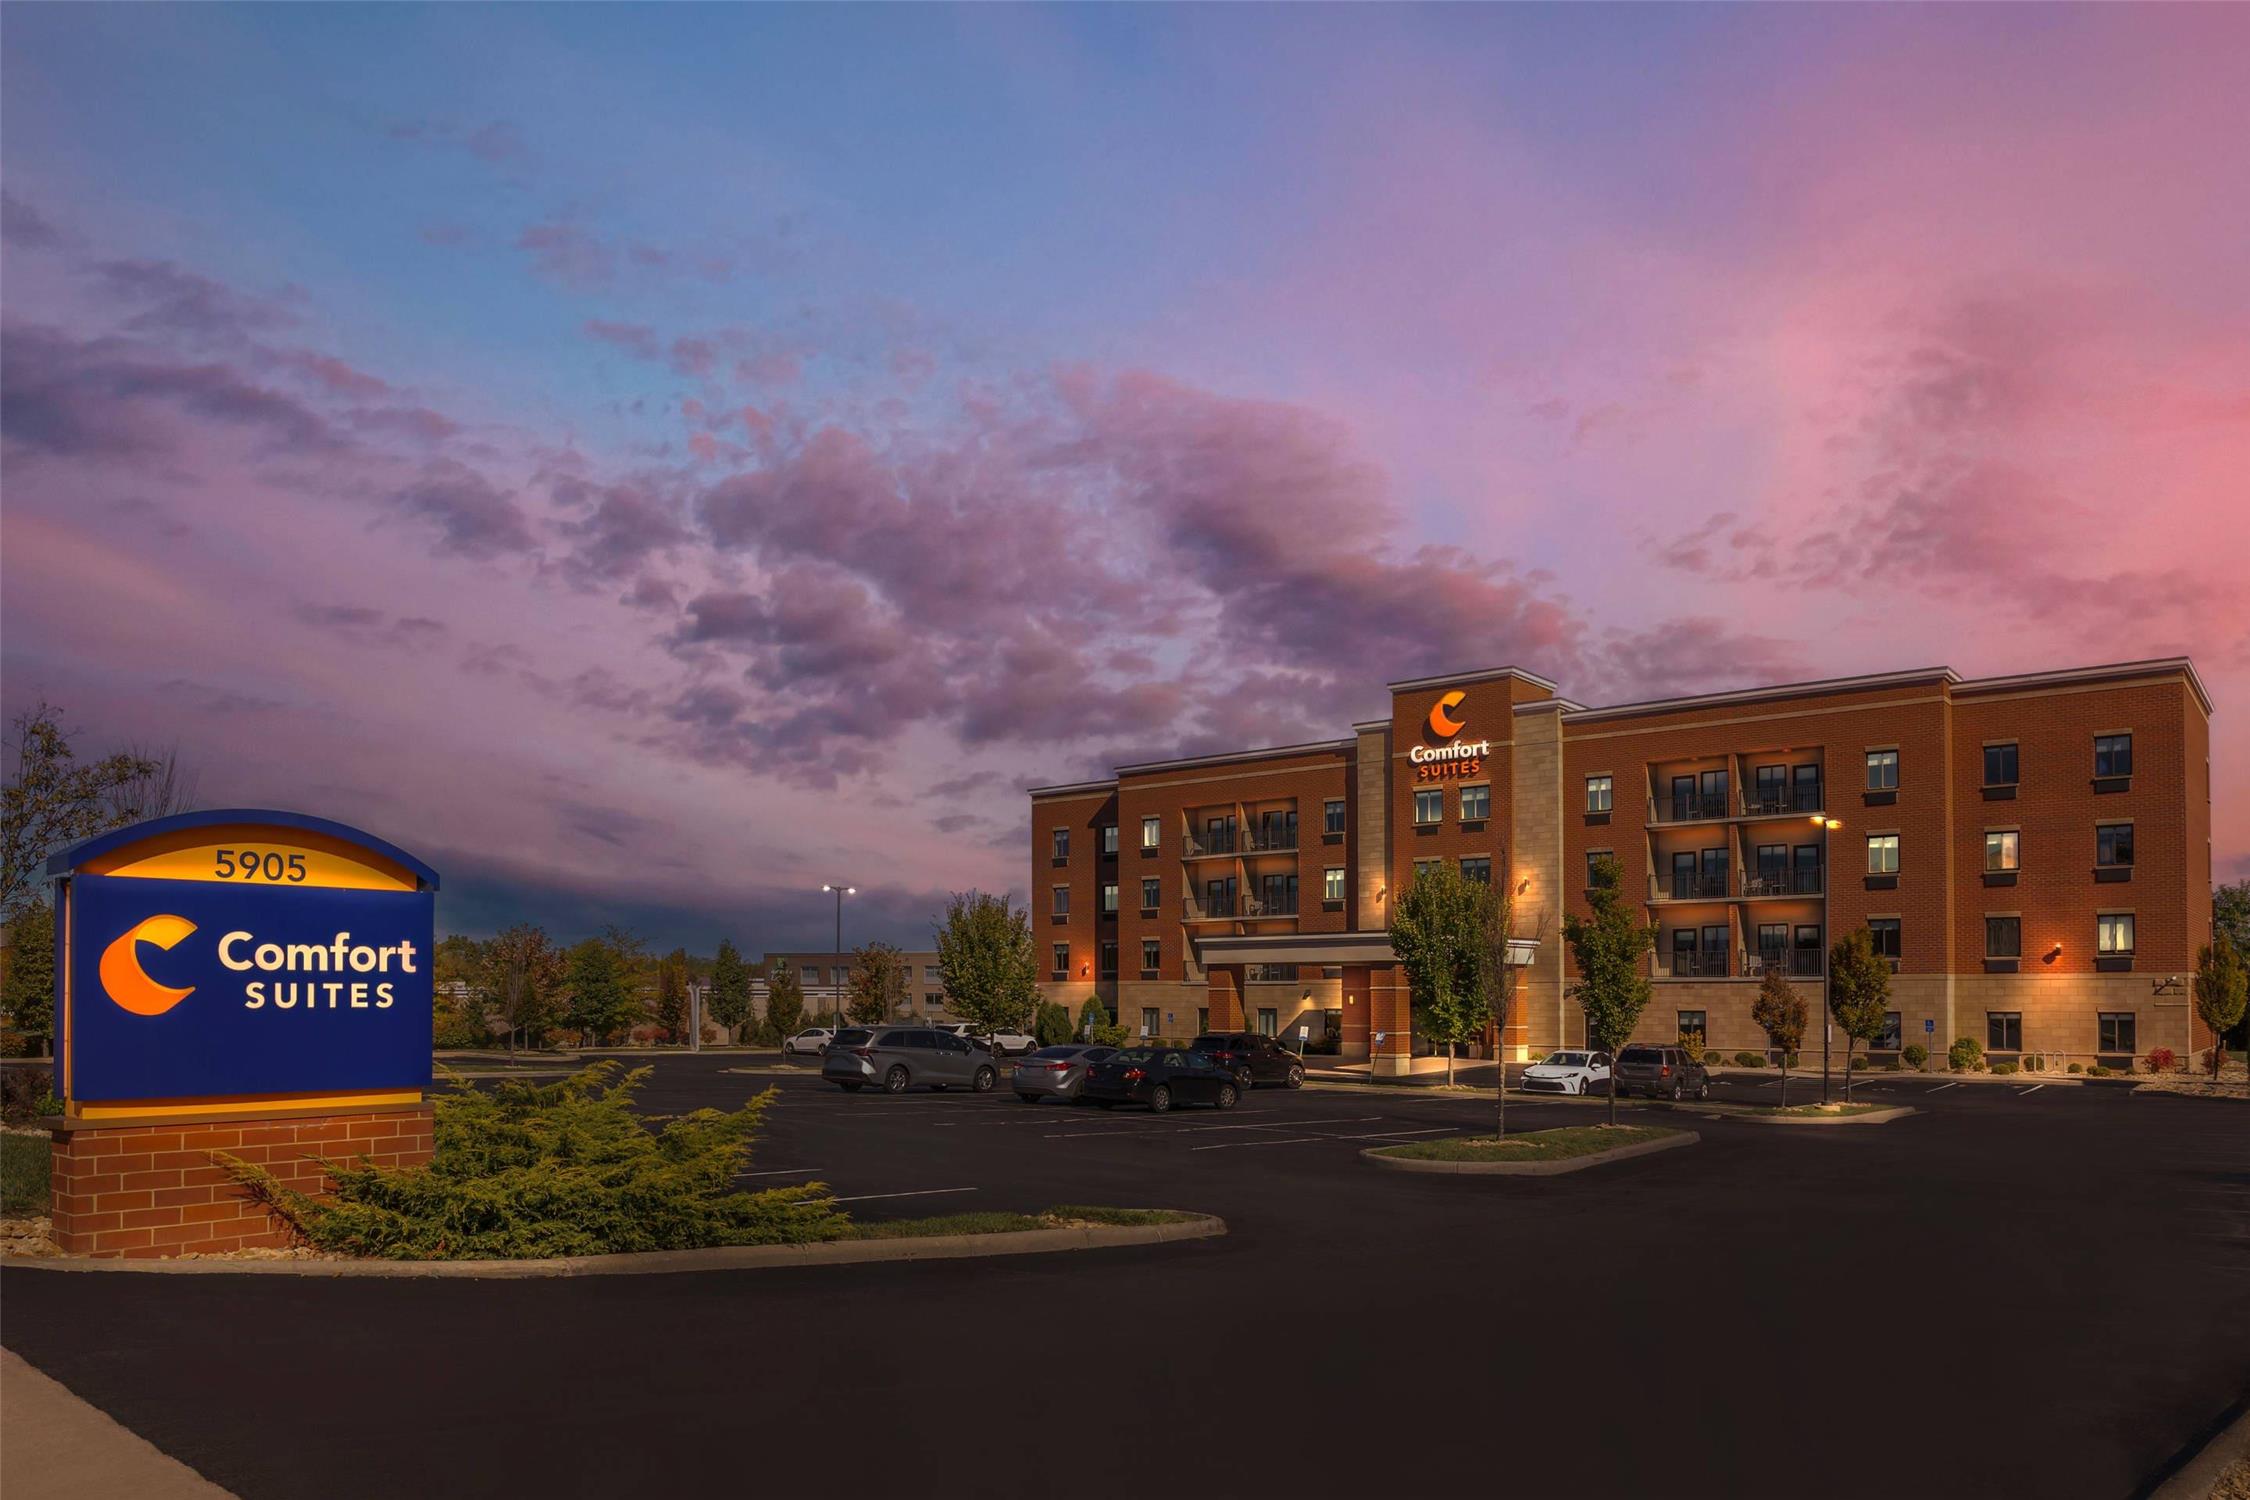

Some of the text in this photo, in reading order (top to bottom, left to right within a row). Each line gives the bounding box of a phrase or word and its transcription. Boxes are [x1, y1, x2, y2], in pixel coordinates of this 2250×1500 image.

[1410, 740, 1490, 763] Comfort
[1420, 760, 1480, 777] SUITES
[215, 849, 306, 882] 5905
[218, 930, 417, 974] Comfort
[244, 981, 395, 1009] SUITES
